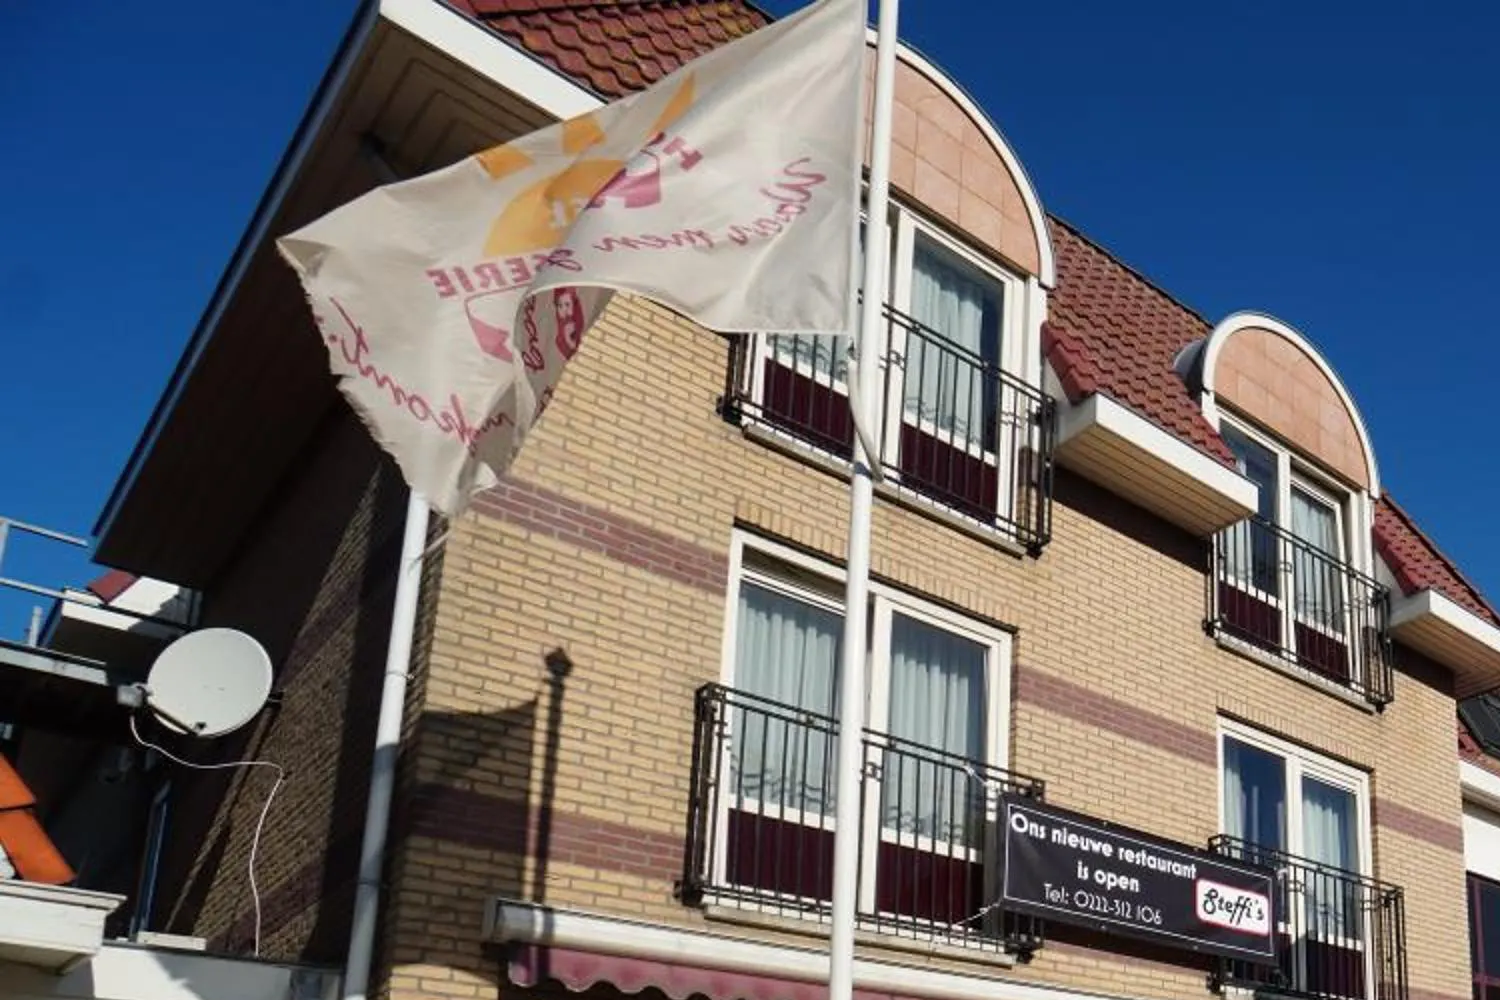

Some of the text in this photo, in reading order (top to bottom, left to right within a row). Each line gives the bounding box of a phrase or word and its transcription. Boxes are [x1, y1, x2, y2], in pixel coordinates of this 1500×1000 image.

[1011, 812, 1197, 879] Ons nieuwe restaurant
[1077, 860, 1140, 893] is open
[1044, 882, 1163, 925] Tel: 0222-312 106
[1202, 888, 1265, 926] Steffi's
